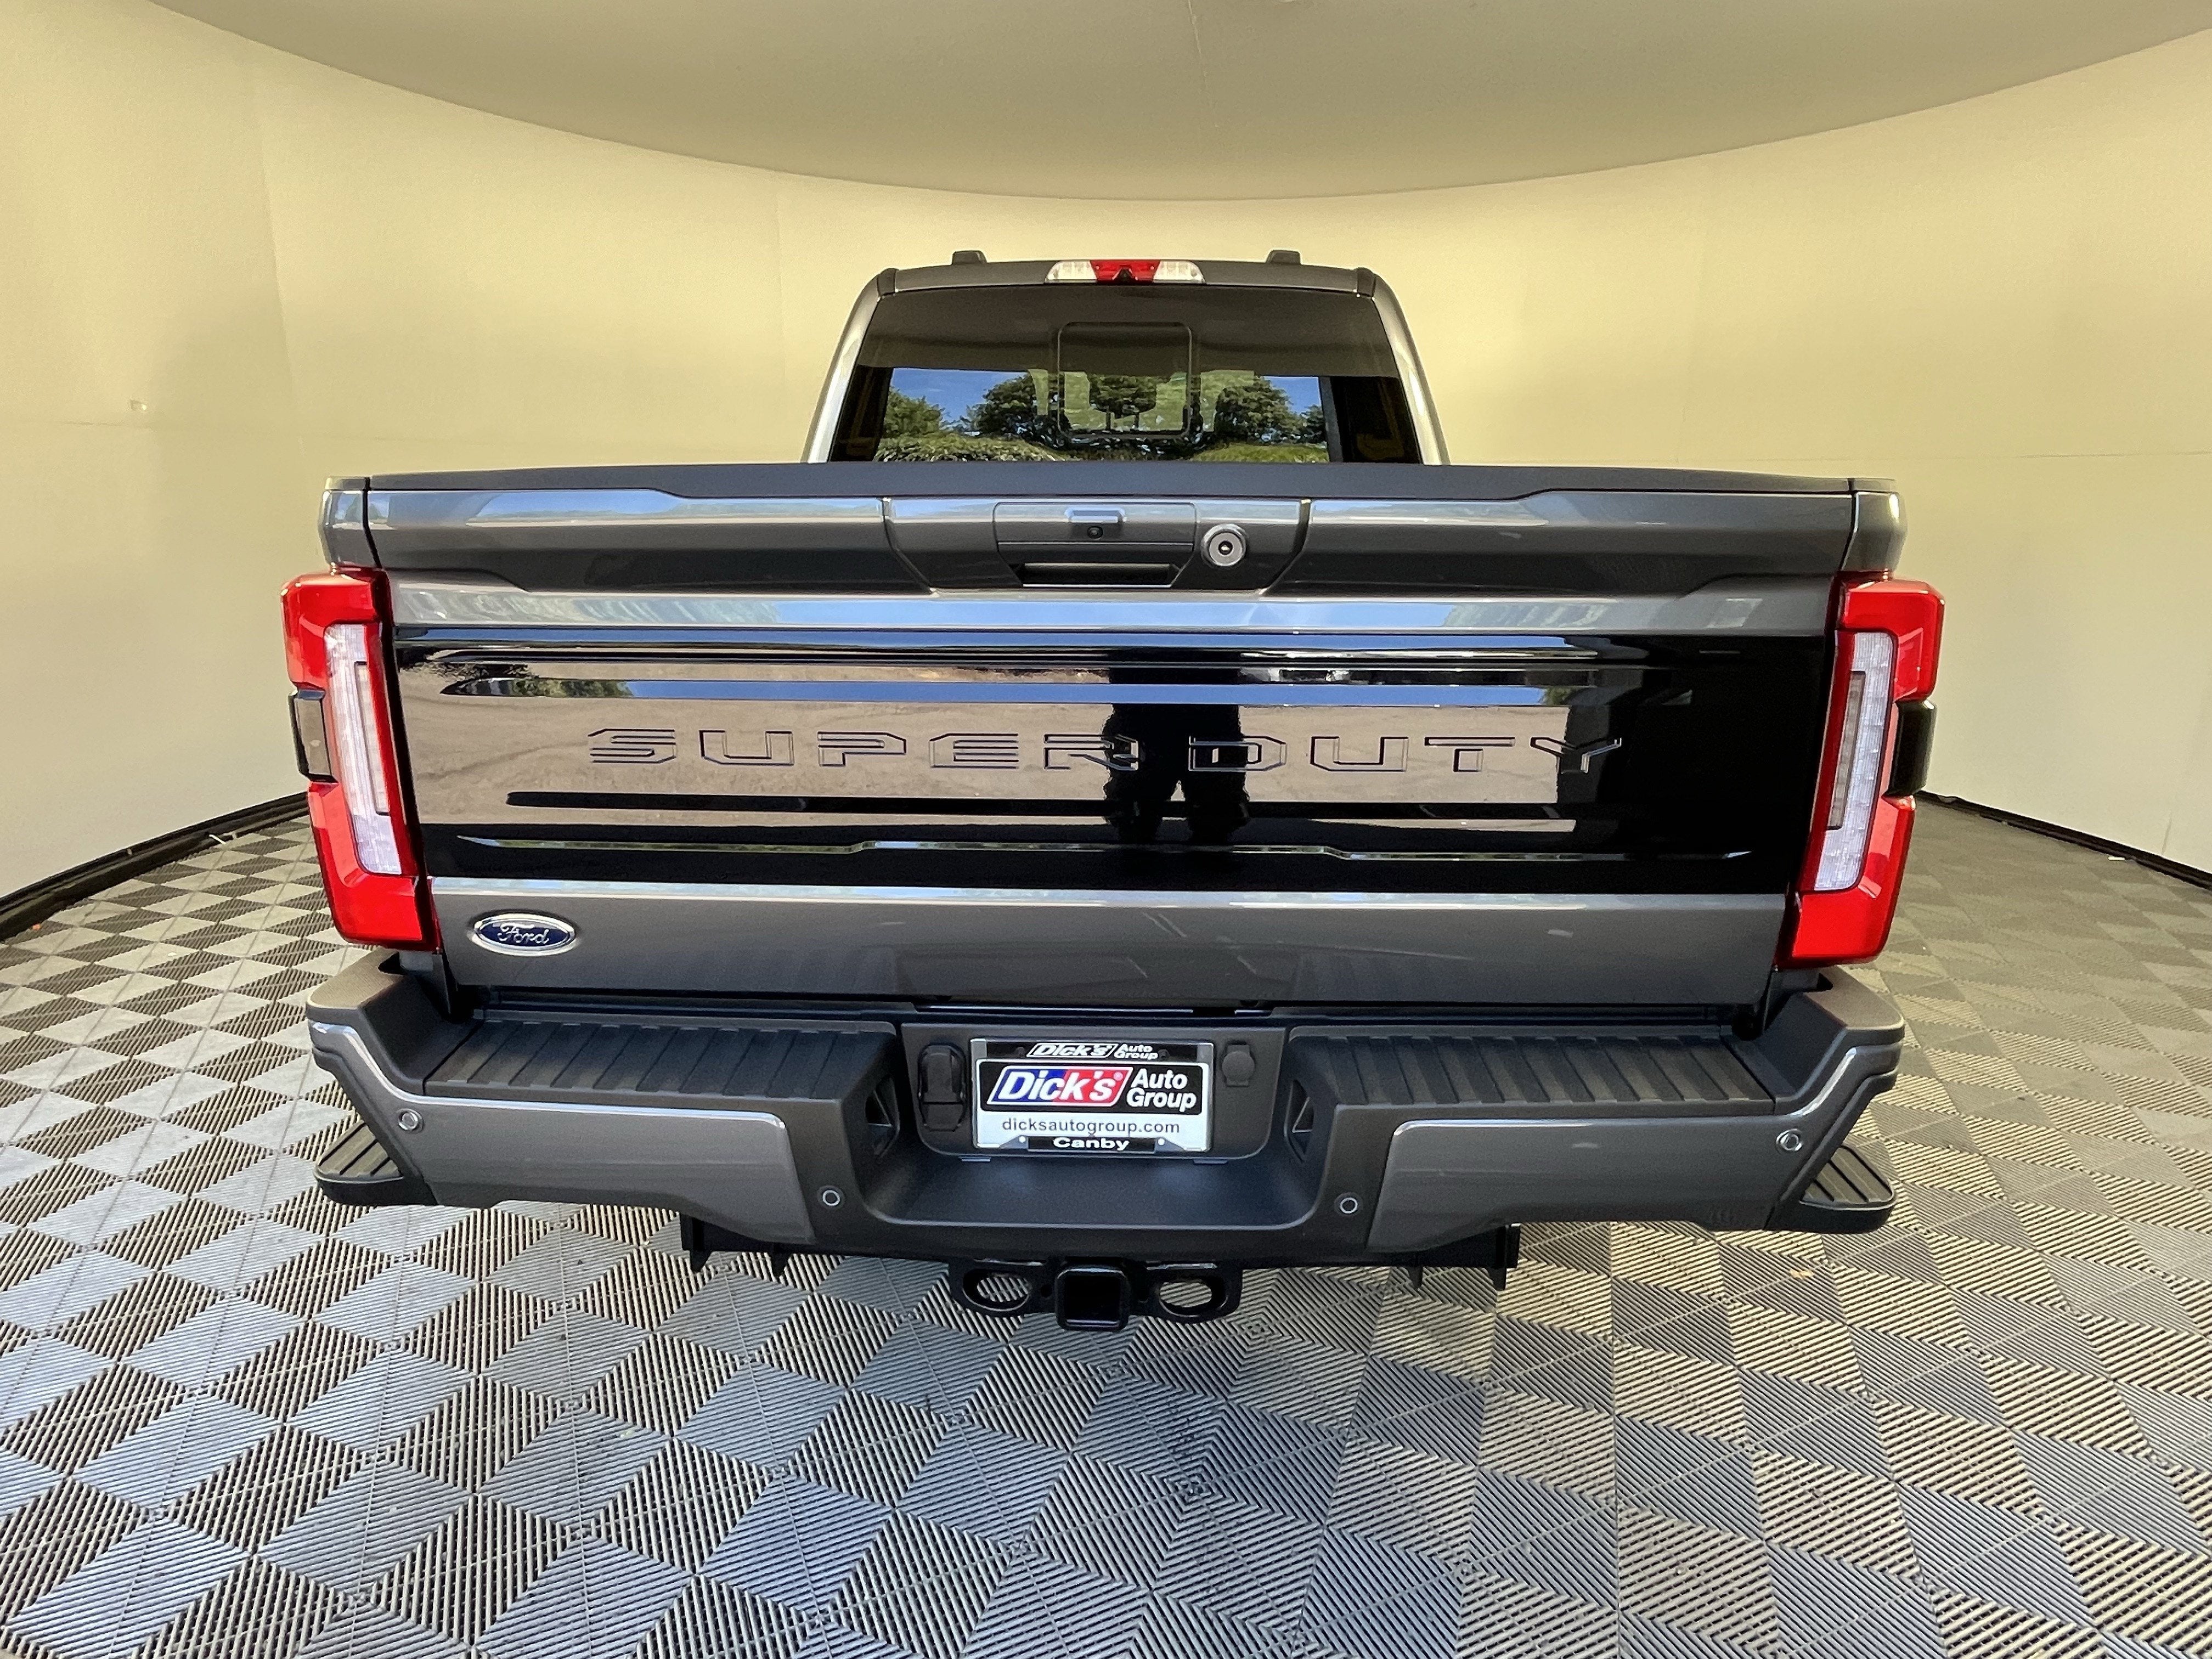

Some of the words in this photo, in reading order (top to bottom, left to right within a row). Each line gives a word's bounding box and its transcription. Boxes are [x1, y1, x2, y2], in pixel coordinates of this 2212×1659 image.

[587, 727, 1139, 770] SUPER
[1188, 735, 1622, 774] DUTY
[497, 922, 550, 945] Ford
[1114, 1052, 1159, 1060] Group
[1119, 1043, 1153, 1052] Auto
[997, 1070, 1116, 1102] Dick's
[1130, 1068, 1188, 1090] Auto
[1126, 1087, 1197, 1113] Group
[1002, 1118, 1180, 1137] dicksautogroup.com
[1052, 1136, 1130, 1152] Canby
